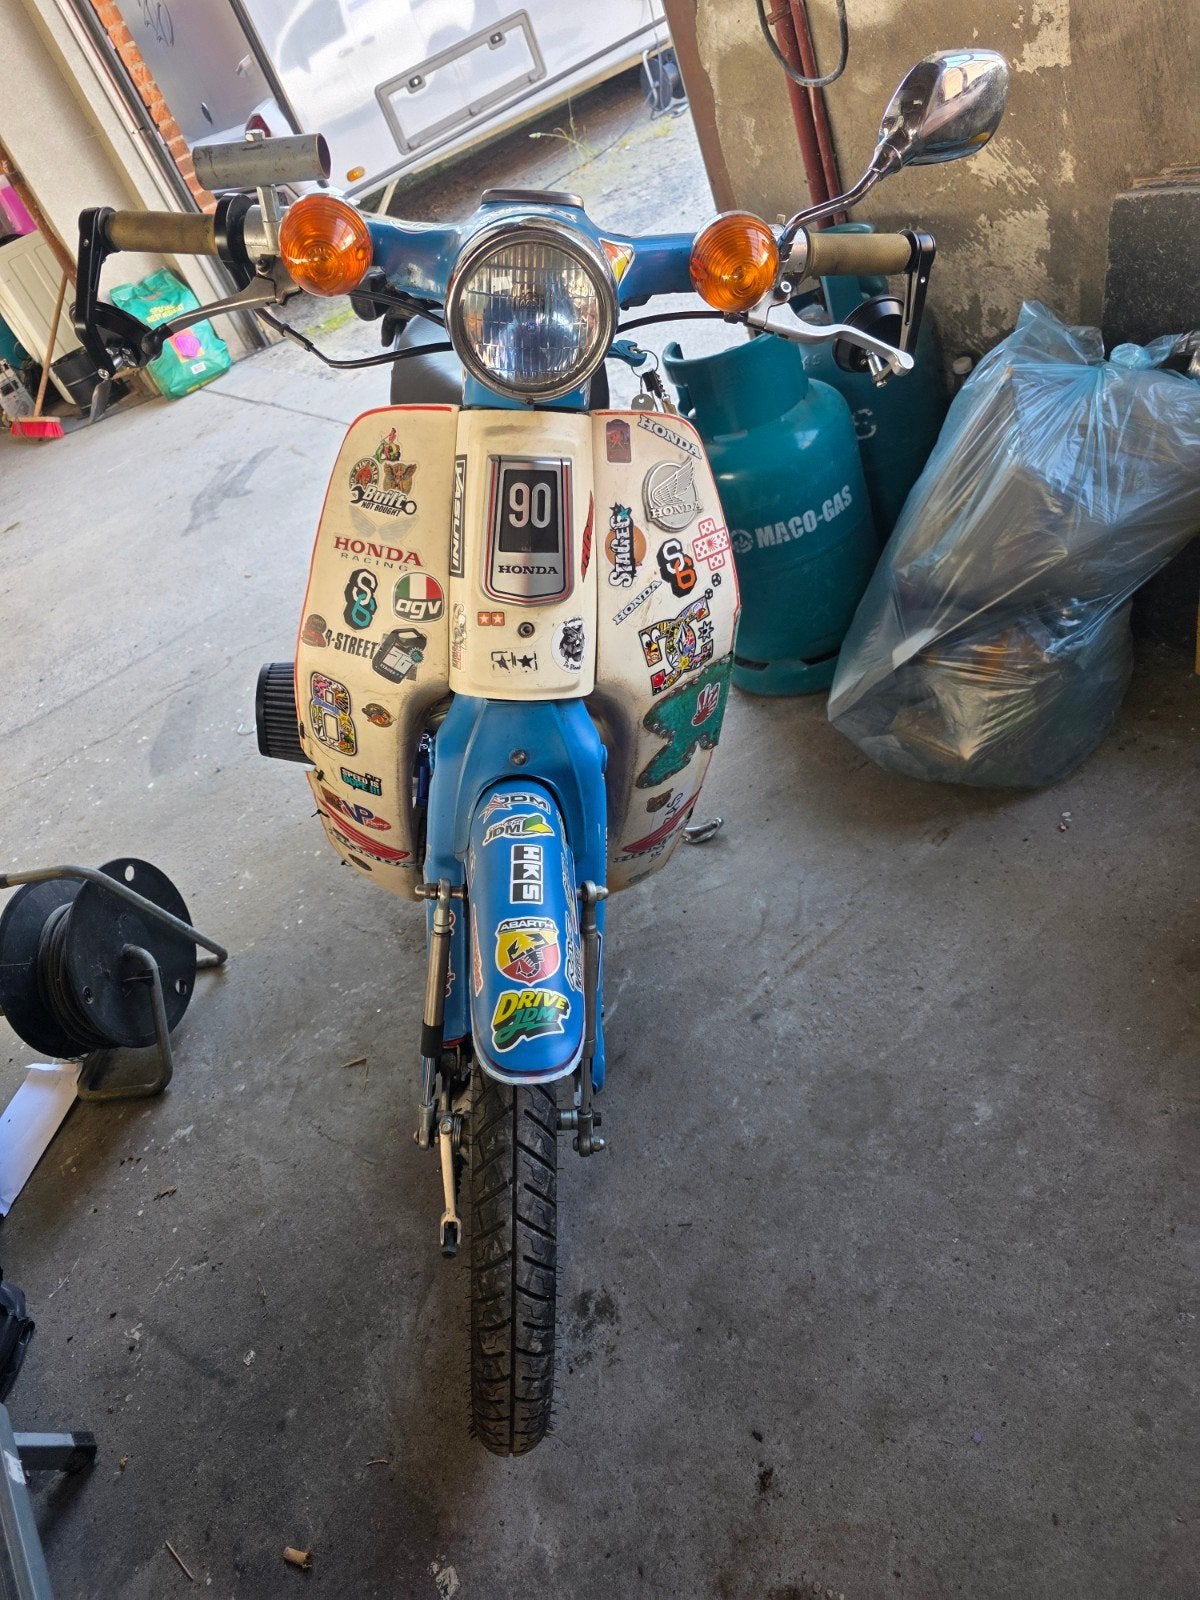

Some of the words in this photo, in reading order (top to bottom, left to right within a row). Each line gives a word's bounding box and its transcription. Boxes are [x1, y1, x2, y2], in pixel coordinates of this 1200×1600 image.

[638, 414, 702, 459] HONDA
[361, 501, 375, 510] NOT
[374, 503, 402, 517] BOUGHT
[362, 484, 407, 508] Built
[509, 482, 551, 528] 90
[452, 462, 466, 567] YASUNI
[650, 501, 703, 519] HONDA
[755, 485, 852, 548] MACO-GAS
[334, 536, 423, 567] HONDA
[341, 552, 409, 572] RACING
[498, 565, 559, 575] HONDA
[395, 598, 442, 619] agv
[613, 579, 662, 625] HONDA
[341, 800, 374, 826] VP
[500, 795, 548, 811] JDM
[485, 824, 521, 844] JDM
[523, 846, 541, 900] HKS
[500, 918, 554, 931] ABARTH
[495, 991, 568, 1025] DRIVE
[494, 1007, 557, 1044] JDM
